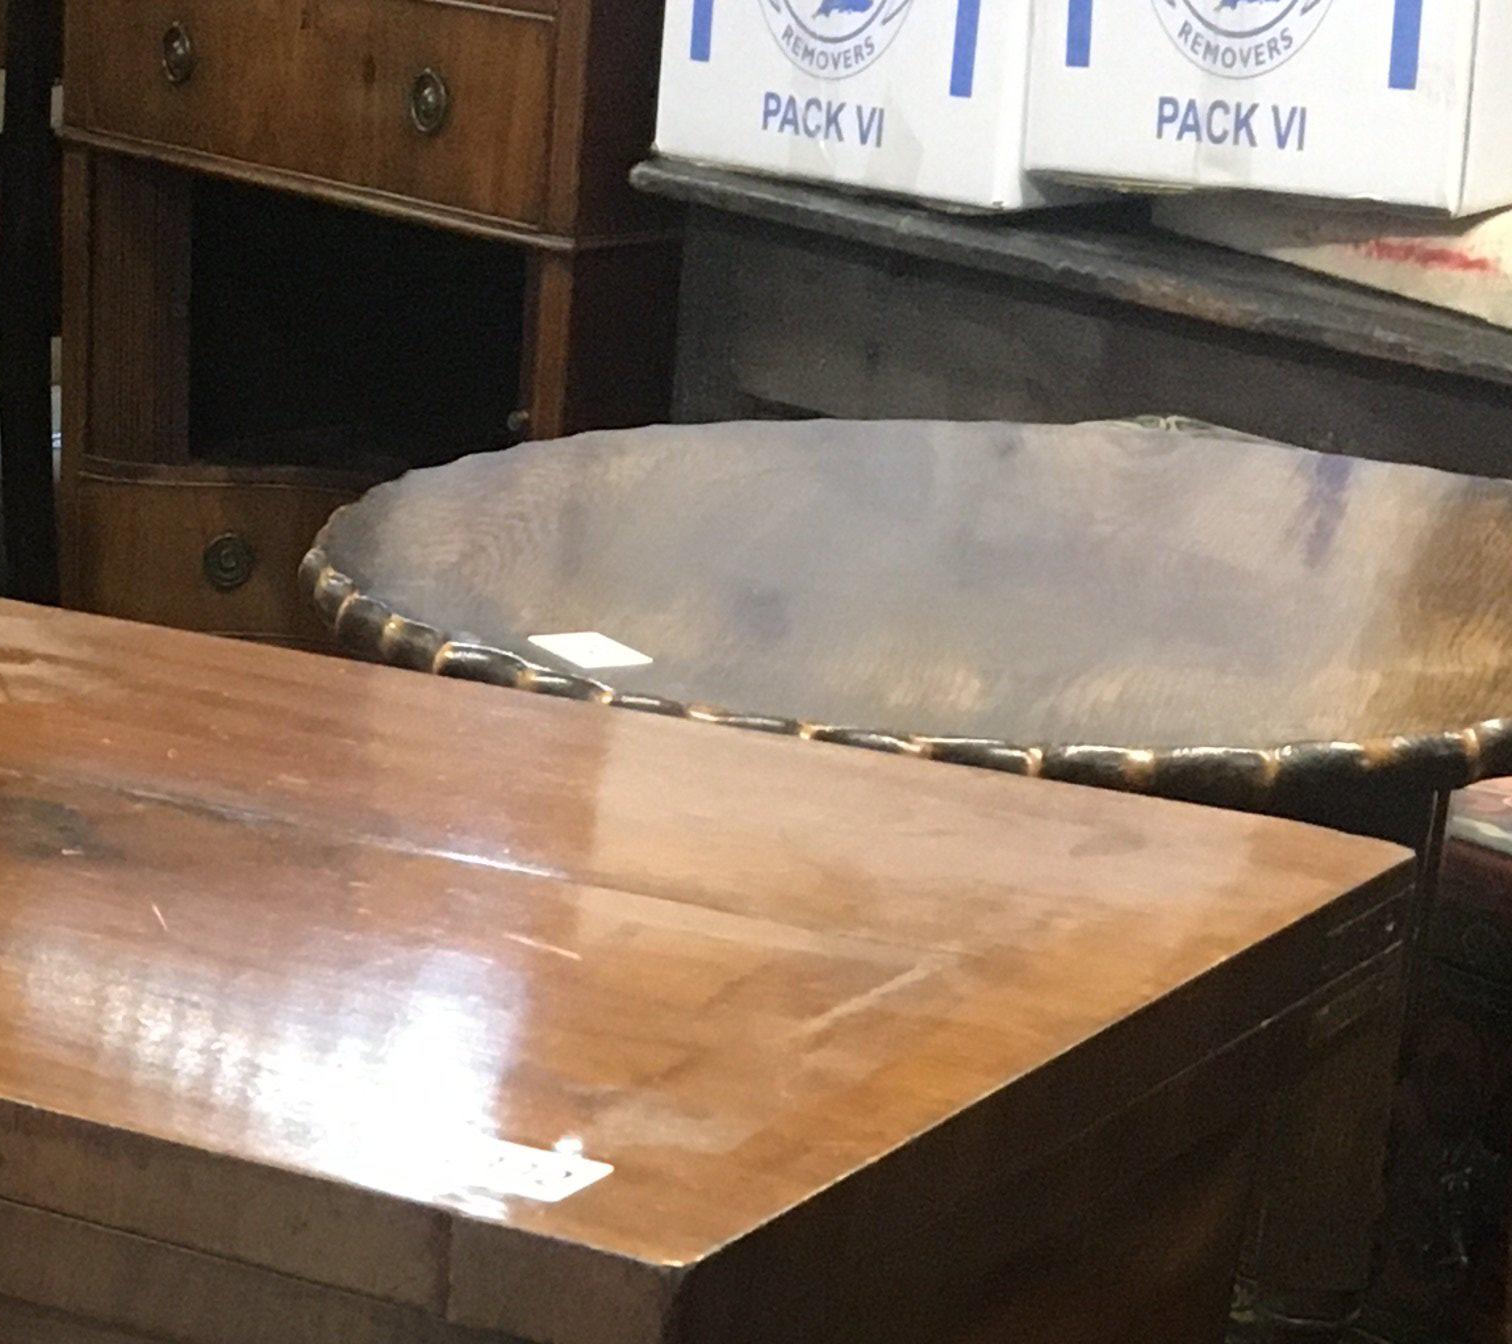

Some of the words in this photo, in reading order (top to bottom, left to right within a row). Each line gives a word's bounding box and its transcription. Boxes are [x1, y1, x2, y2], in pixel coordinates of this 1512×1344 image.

[781, 24, 876, 70] REMOVERS
[1178, 20, 1294, 68] REMOVERS
[762, 91, 845, 142] PACK
[856, 105, 885, 148] VI
[1156, 96, 1259, 147] PACK
[1272, 105, 1308, 151] VI
